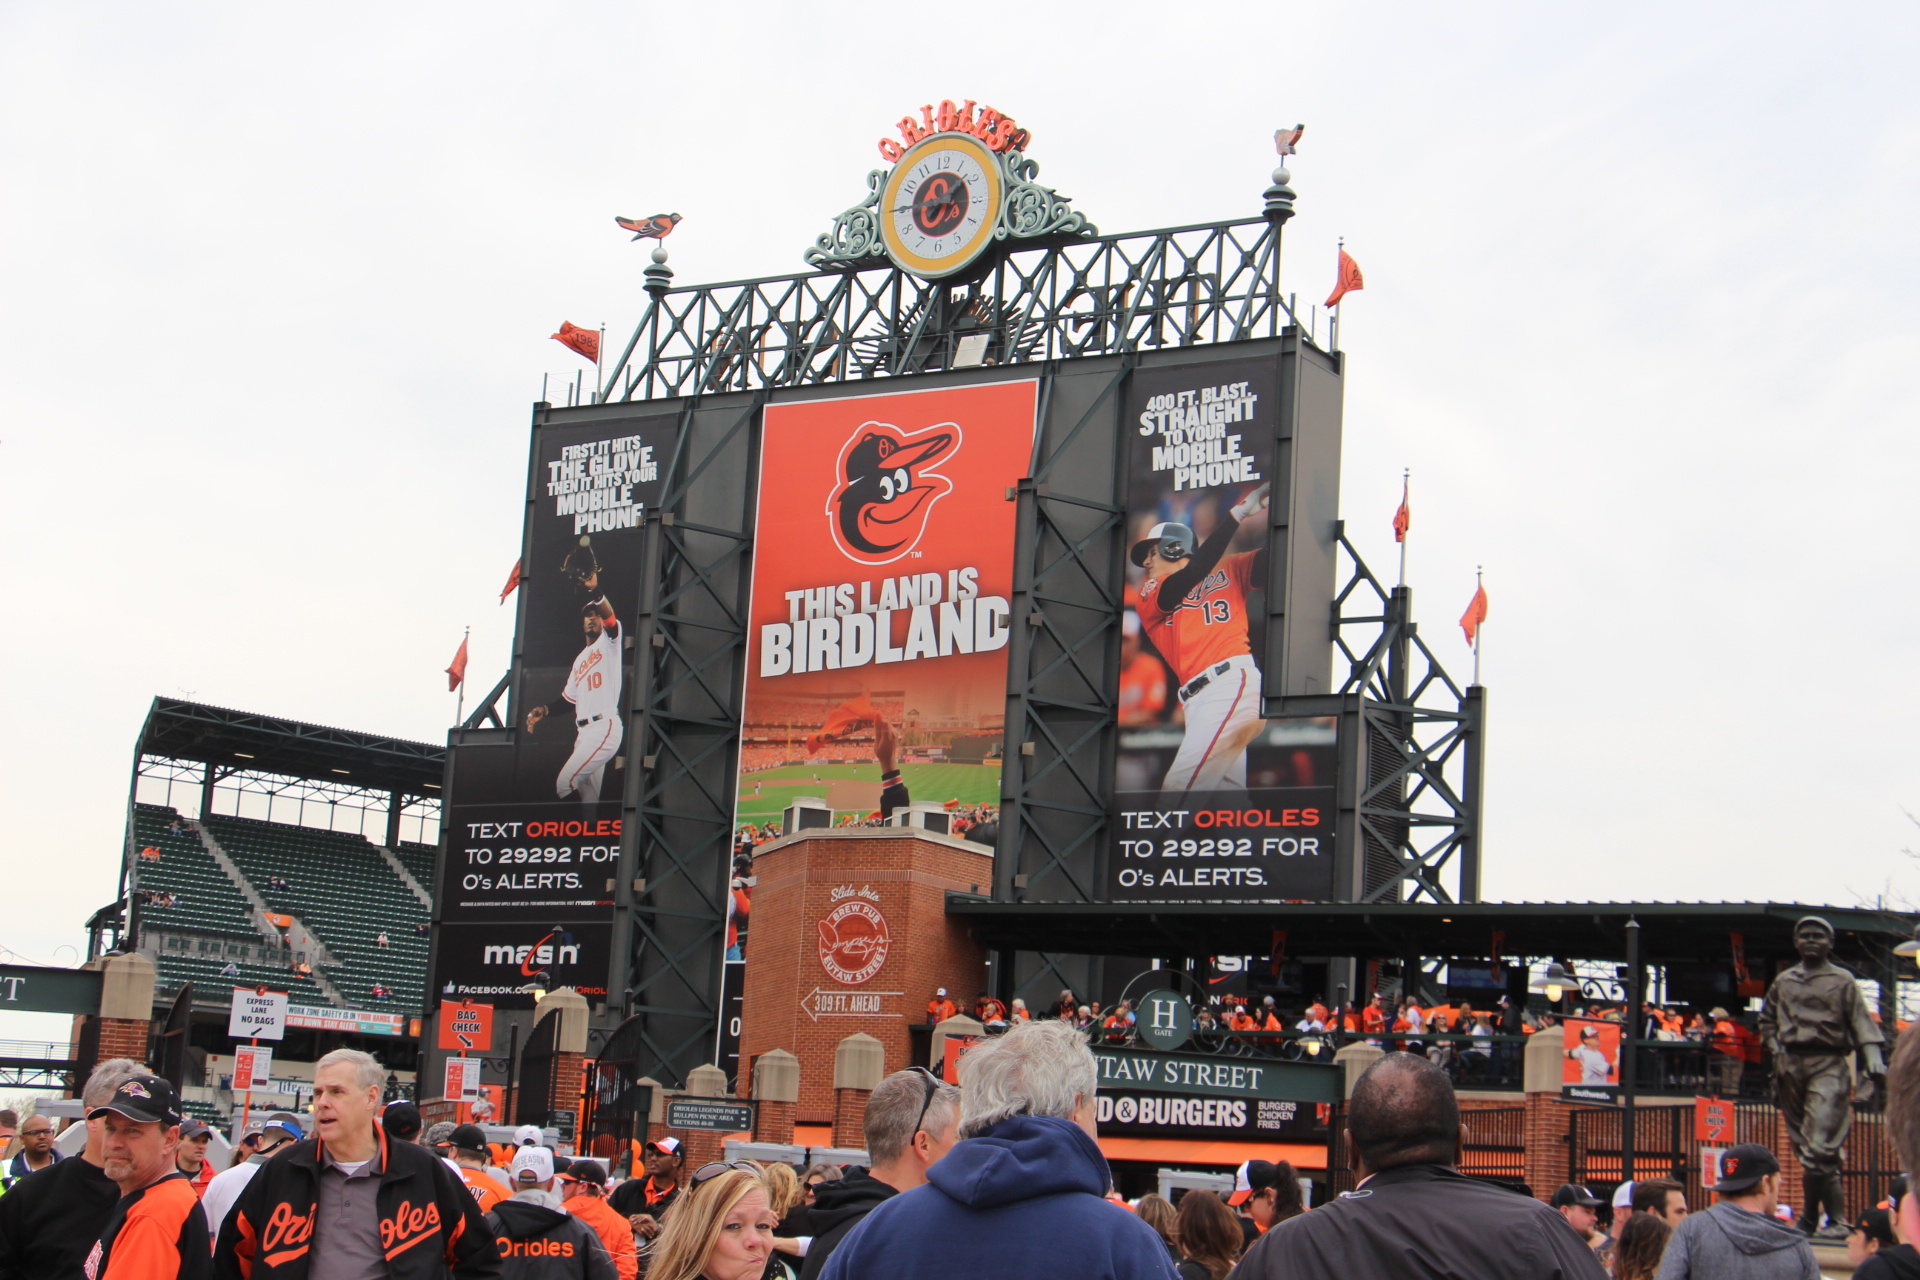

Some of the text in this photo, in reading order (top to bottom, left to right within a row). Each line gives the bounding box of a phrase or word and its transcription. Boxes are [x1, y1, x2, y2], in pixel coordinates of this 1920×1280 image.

[878, 99, 1016, 163] ORIOLES
[918, 164, 931, 178] 11
[936, 156, 950, 170] 12
[956, 160, 964, 172] 1
[904, 180, 918, 195] 10
[967, 174, 979, 186] 2
[902, 224, 914, 235] 8
[967, 216, 977, 227] 4
[915, 236, 926, 248] 7
[934, 239, 942, 252] 6
[953, 232, 962, 245] 5
[1146, 381, 1252, 412] 400 FT. BLAST.
[1139, 394, 1258, 437] STRAIGHT
[1163, 422, 1226, 447] TO YOUR
[562, 434, 641, 460] FIRST IT HITS
[1152, 434, 1242, 472] MOBILE
[548, 446, 657, 482] THE GLOVE.
[547, 467, 657, 496] THEN IT HITS YOUR
[1174, 455, 1260, 492] PHONE.
[557, 483, 633, 516] MOBILE
[785, 567, 978, 623] THIS LAND IS
[1202, 599, 1231, 626] 13
[760, 596, 1010, 678] BIRDLAND
[587, 672, 602, 691] 10
[1121, 808, 1320, 829] TEXT ORIOLES
[467, 820, 622, 838] TEXT ORIOLES
[465, 848, 493, 864] TO
[498, 847, 572, 864] 29292
[1119, 838, 1319, 858] TO 29292 FOR
[462, 872, 582, 890] O's ALERTS.
[1118, 868, 1268, 887] O's ALERTS.
[831, 884, 880, 902] Slide Into
[832, 904, 880, 924] BREW PUB
[824, 946, 886, 982] EUTAW STREET
[0, 976, 26, 1001] T
[246, 998, 274, 1006] EXPRESS
[815, 996, 880, 1012] 309 FT. AHEAD
[254, 1017, 274, 1025] BAGS
[288, 1006, 304, 1015] WORK
[306, 1008, 320, 1016] ZONE
[321, 1010, 342, 1019] SAFETY
[457, 1010, 476, 1020] BAG
[1150, 1000, 1178, 1029] H
[286, 1016, 302, 1026] SLOW
[324, 1020, 338, 1028] STAY
[451, 1022, 481, 1032] CHECK
[1095, 1055, 1264, 1090] TAW STREET
[1571, 1088, 1606, 1099] Southwest
[1138, 1098, 1246, 1128] BURGERS
[1258, 1101, 1296, 1112] BURGERS
[1258, 1111, 1294, 1120] CHICKEN
[1708, 1106, 1723, 1114] BAG
[1258, 1120, 1280, 1129] FRIES
[1704, 1116, 1726, 1126] CHECK
[496, 1237, 574, 1258] Orioles
